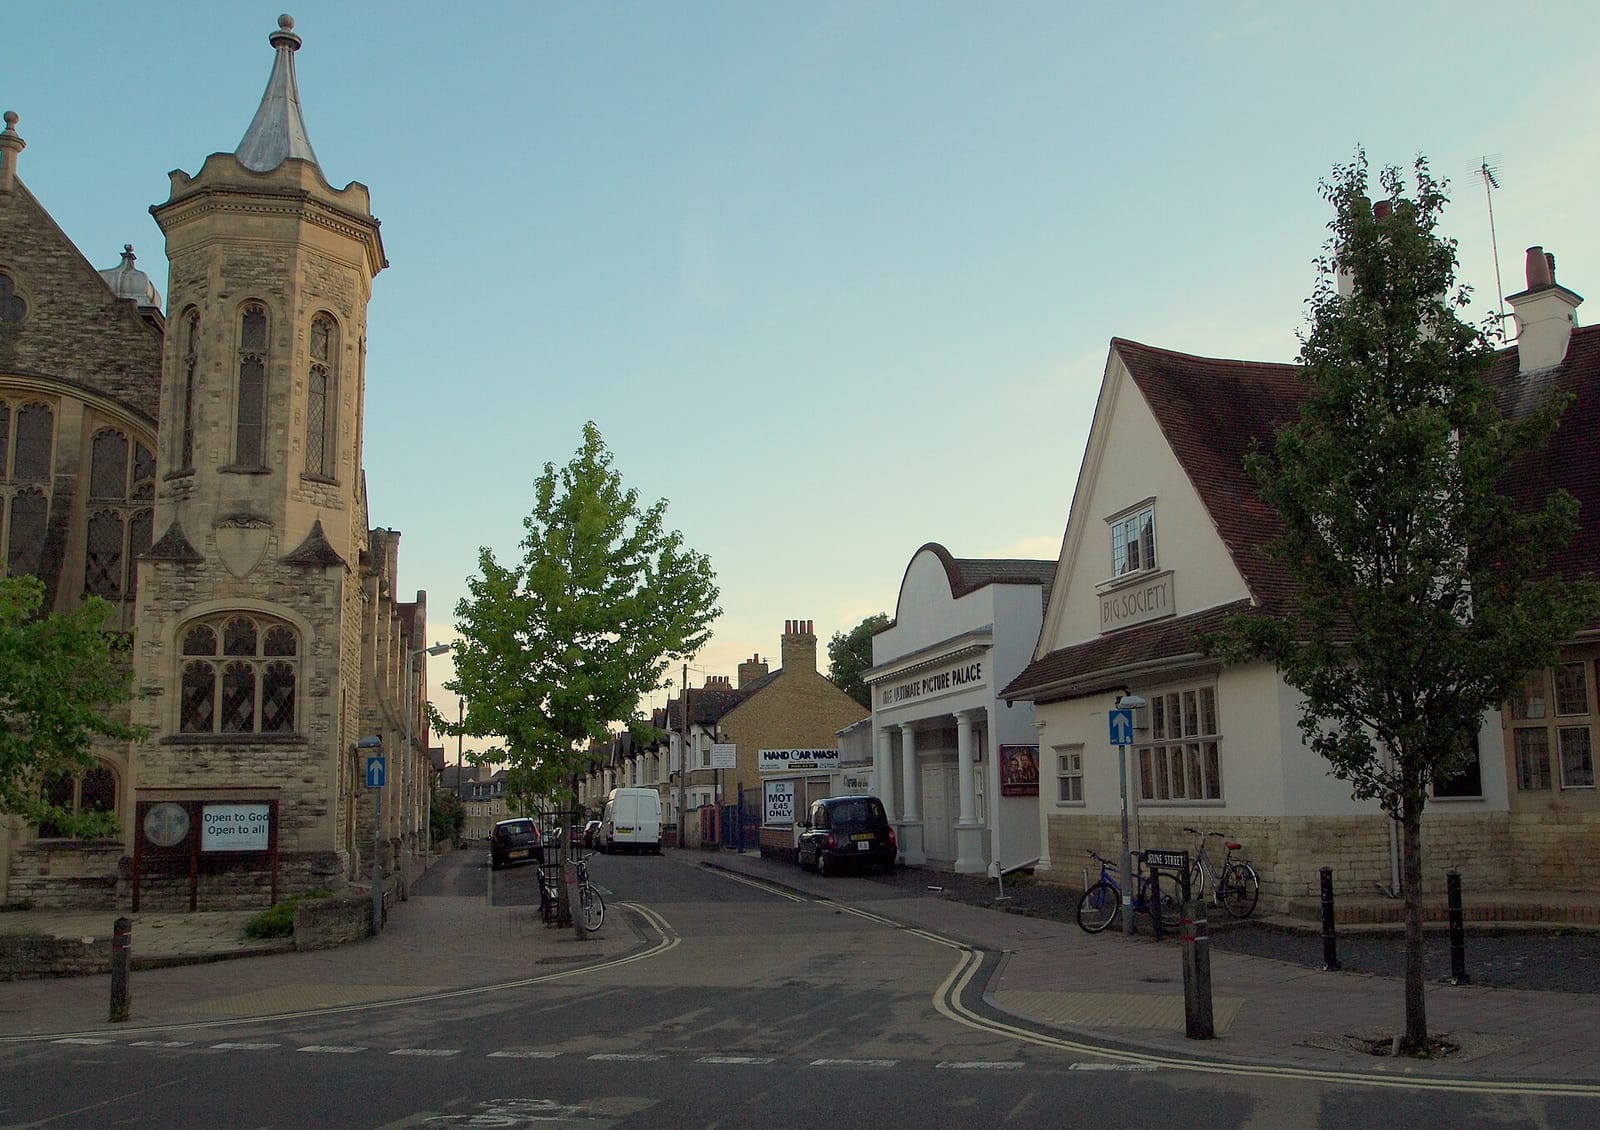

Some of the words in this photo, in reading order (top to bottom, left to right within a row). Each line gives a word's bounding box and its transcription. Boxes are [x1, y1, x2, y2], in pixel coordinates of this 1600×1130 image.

[1103, 599, 1120, 623] BIG
[1122, 583, 1166, 618] SOCIETY
[922, 672, 950, 695] PICTURE
[952, 663, 981, 685] PALACE
[763, 751, 790, 760] HAND
[791, 750, 811, 760] CAR
[812, 750, 838, 759] WASH
[768, 794, 793, 803] MOT
[204, 813, 232, 824] Open
[234, 813, 245, 821] to
[248, 812, 269, 821] God
[208, 825, 235, 836] Open
[238, 826, 249, 834] to
[252, 825, 265, 834] all
[1164, 855, 1183, 866] STREET
